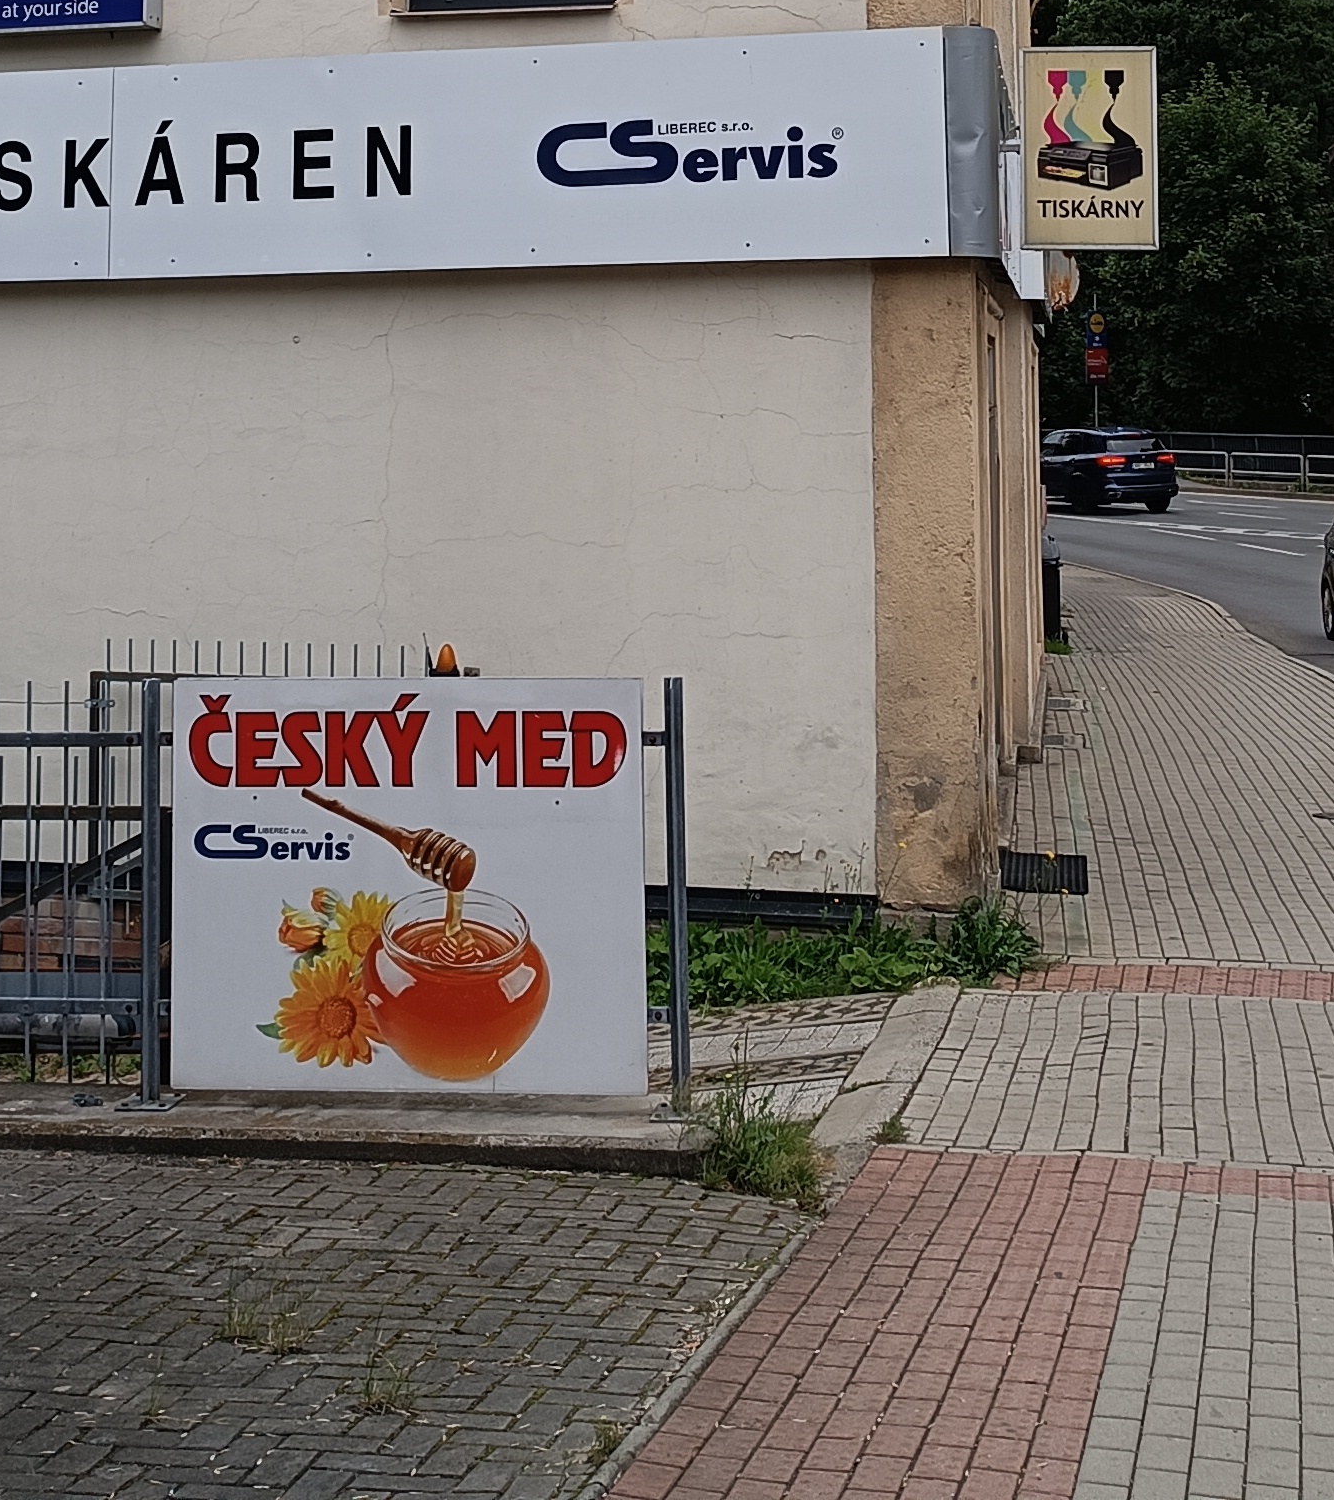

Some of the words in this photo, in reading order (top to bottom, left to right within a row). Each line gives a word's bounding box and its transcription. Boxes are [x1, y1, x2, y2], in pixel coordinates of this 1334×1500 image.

[2, 4, 19, 19] at
[23, 2, 62, 21] your
[657, 121, 717, 136] LIBEREC
[720, 121, 754, 132] s.r.o.
[1037, 195, 1144, 218] TISKÁRNY
[188, 693, 430, 788] ČESKÝ
[455, 710, 627, 788] MED
